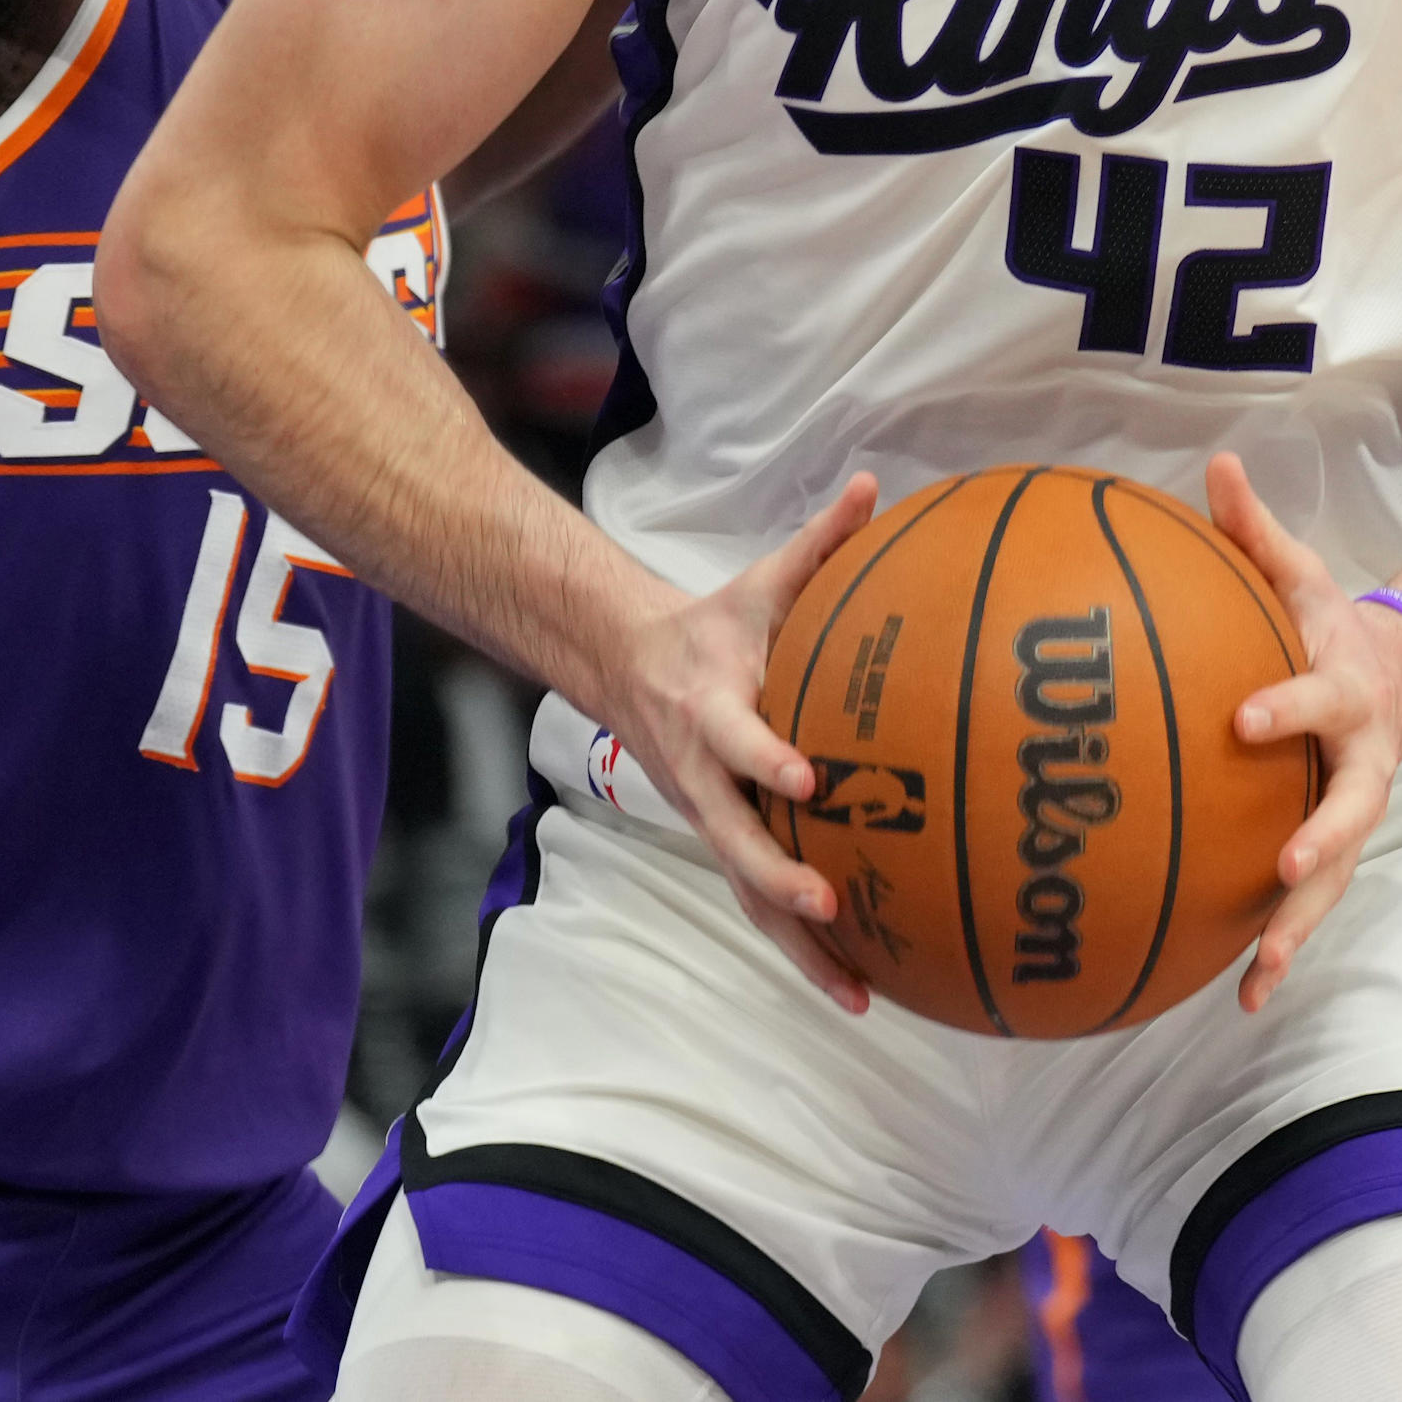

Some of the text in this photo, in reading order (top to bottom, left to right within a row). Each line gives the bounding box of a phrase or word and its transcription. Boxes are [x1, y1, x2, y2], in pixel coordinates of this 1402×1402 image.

[1004, 146, 1332, 374] 42
[138, 488, 356, 789] 15
[1012, 605, 1122, 985] Wilson
